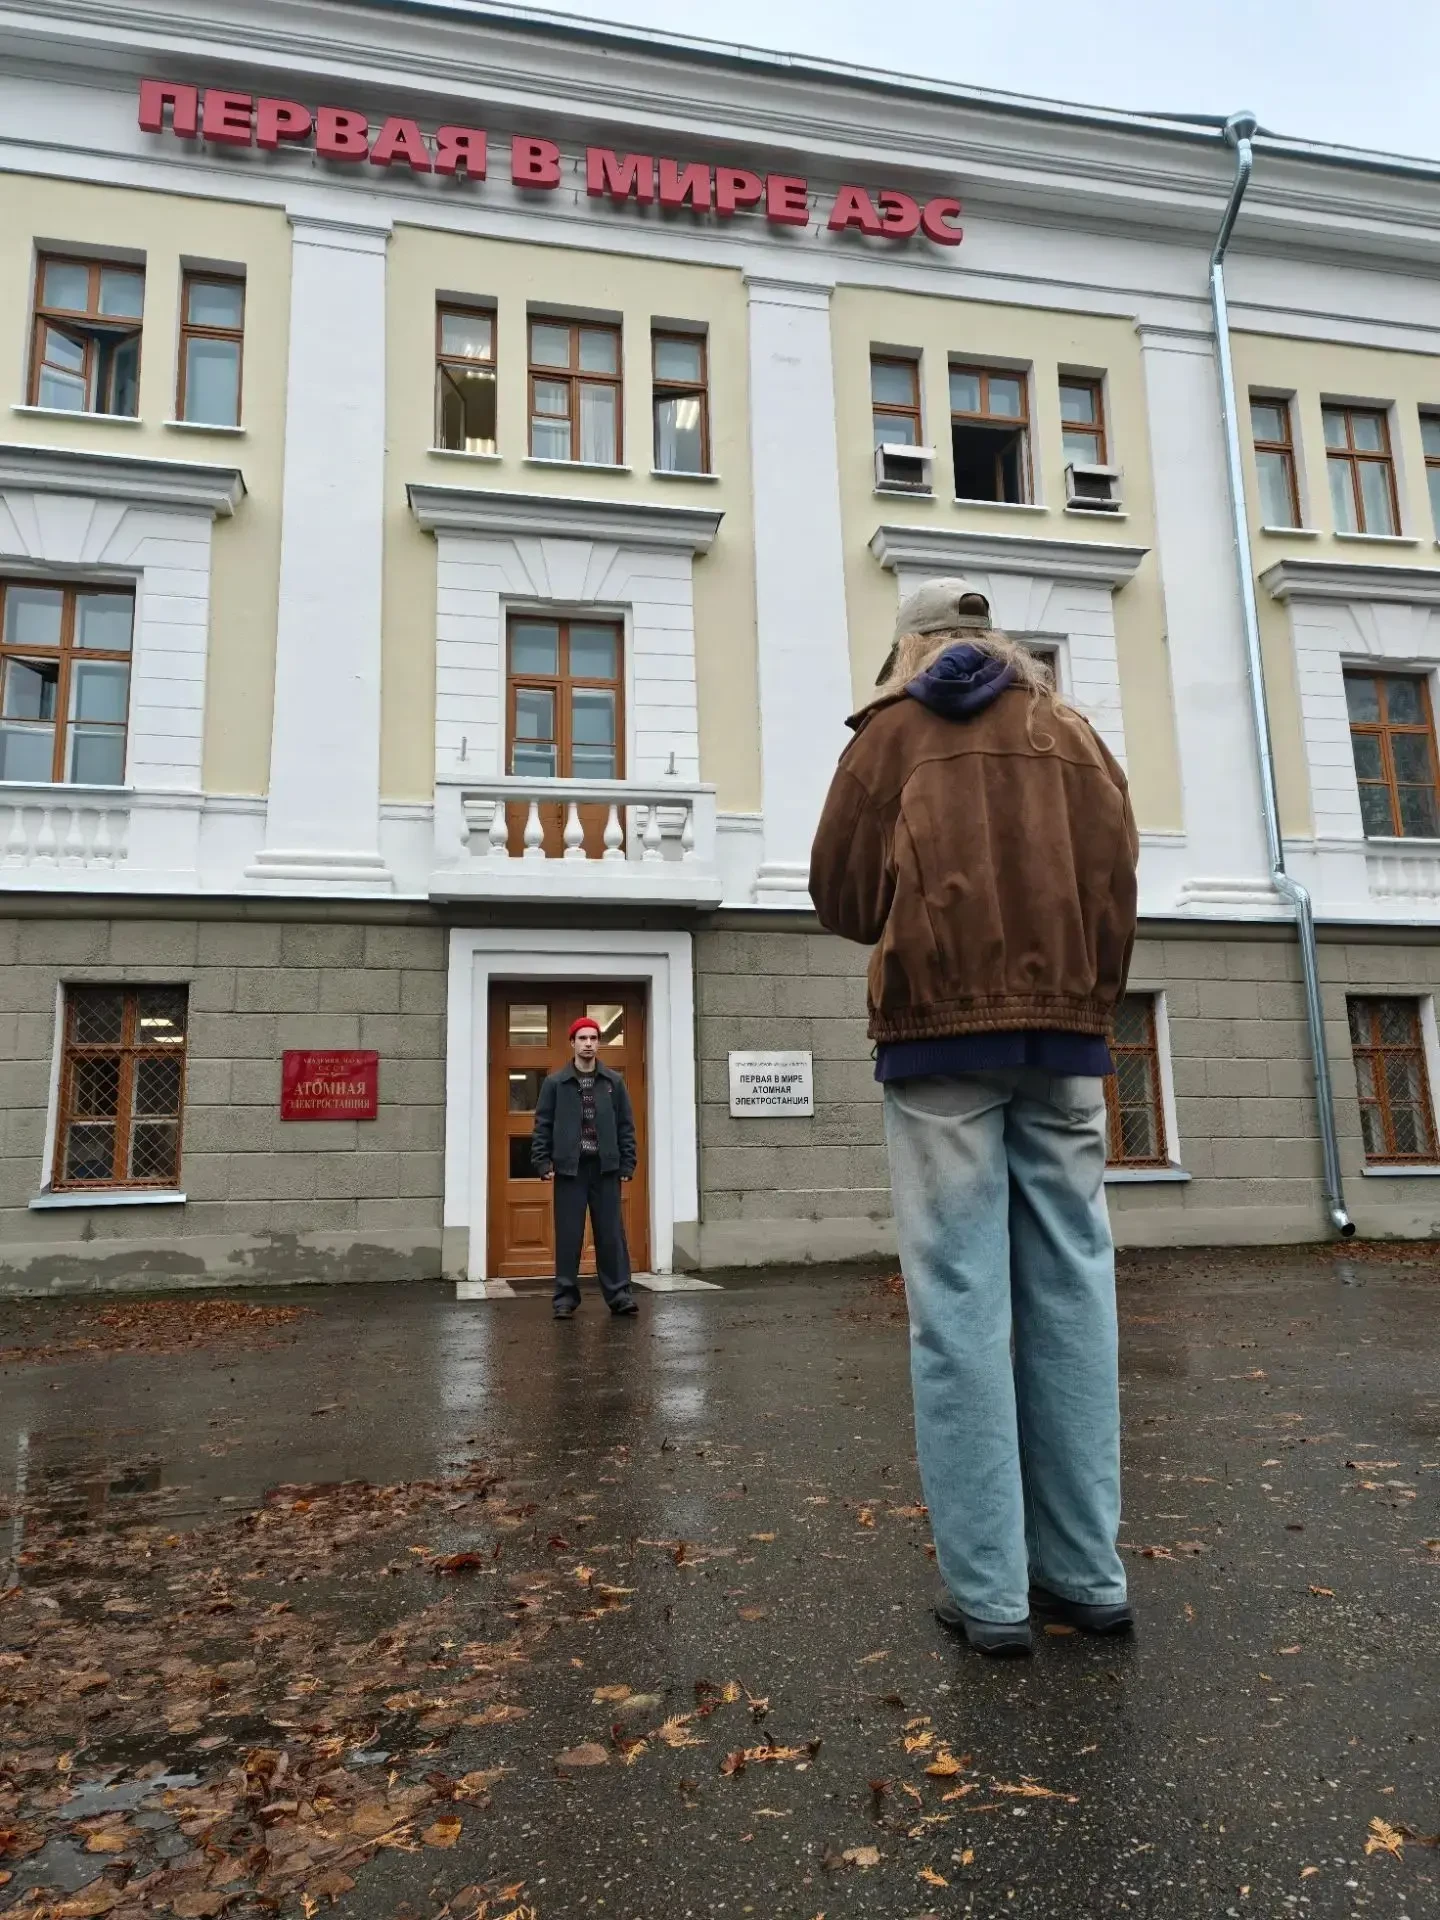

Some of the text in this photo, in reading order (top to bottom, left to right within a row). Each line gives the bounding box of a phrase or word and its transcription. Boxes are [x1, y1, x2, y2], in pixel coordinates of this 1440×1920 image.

[138, 78, 963, 247] ПЕРВАЯ В МИРЕ АЭС
[740, 1075, 804, 1083] ПЕРВАЯ В МИРЕ
[294, 1081, 366, 1096] АТОМНАЯ
[752, 1086, 792, 1094] АТОМНАЯ
[289, 1099, 370, 1110] ЭЛЕКТРОСТАНЦИЯ
[735, 1097, 809, 1106] ЭЛЕКТРОСТАНЦИЯ
